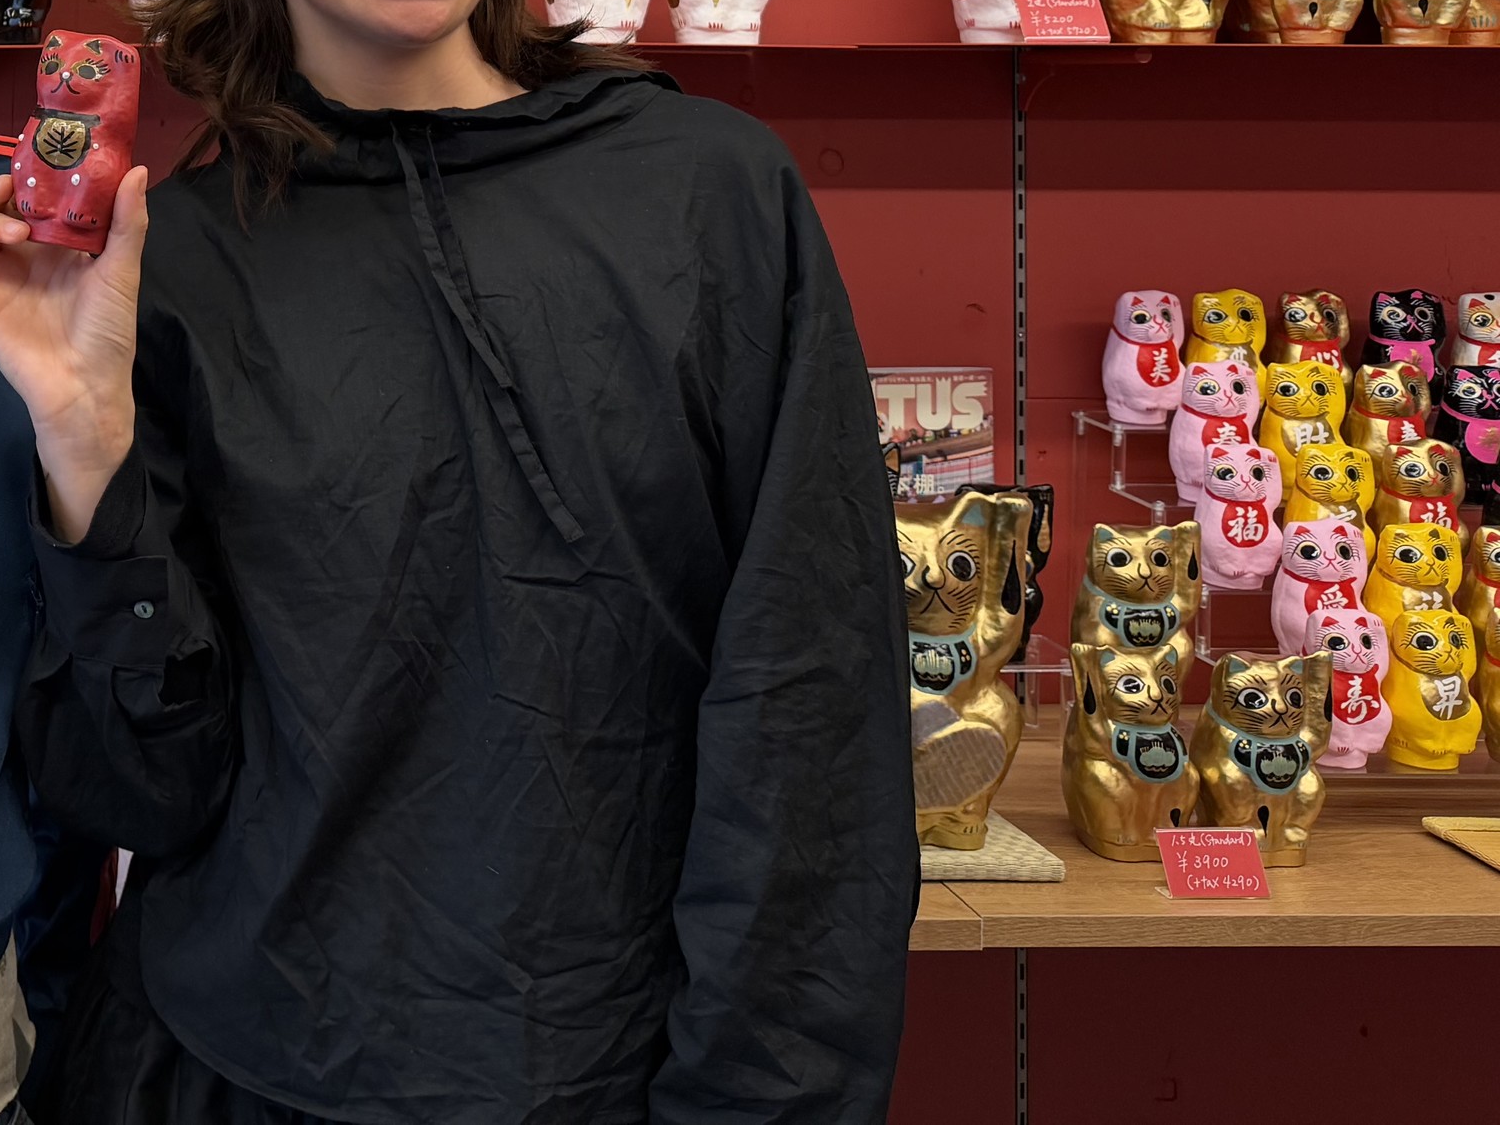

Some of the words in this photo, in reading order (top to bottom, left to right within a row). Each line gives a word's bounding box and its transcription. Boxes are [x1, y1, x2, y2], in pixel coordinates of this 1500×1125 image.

[1150, 347, 1171, 382] 美
[872, 377, 988, 431] TUS
[1227, 505, 1265, 542] 福
[1340, 674, 1380, 725] 寿
[1432, 675, 1464, 720] 昇
[1176, 850, 1229, 873] ¥3900
[1223, 874, 1260, 891] 4290)
